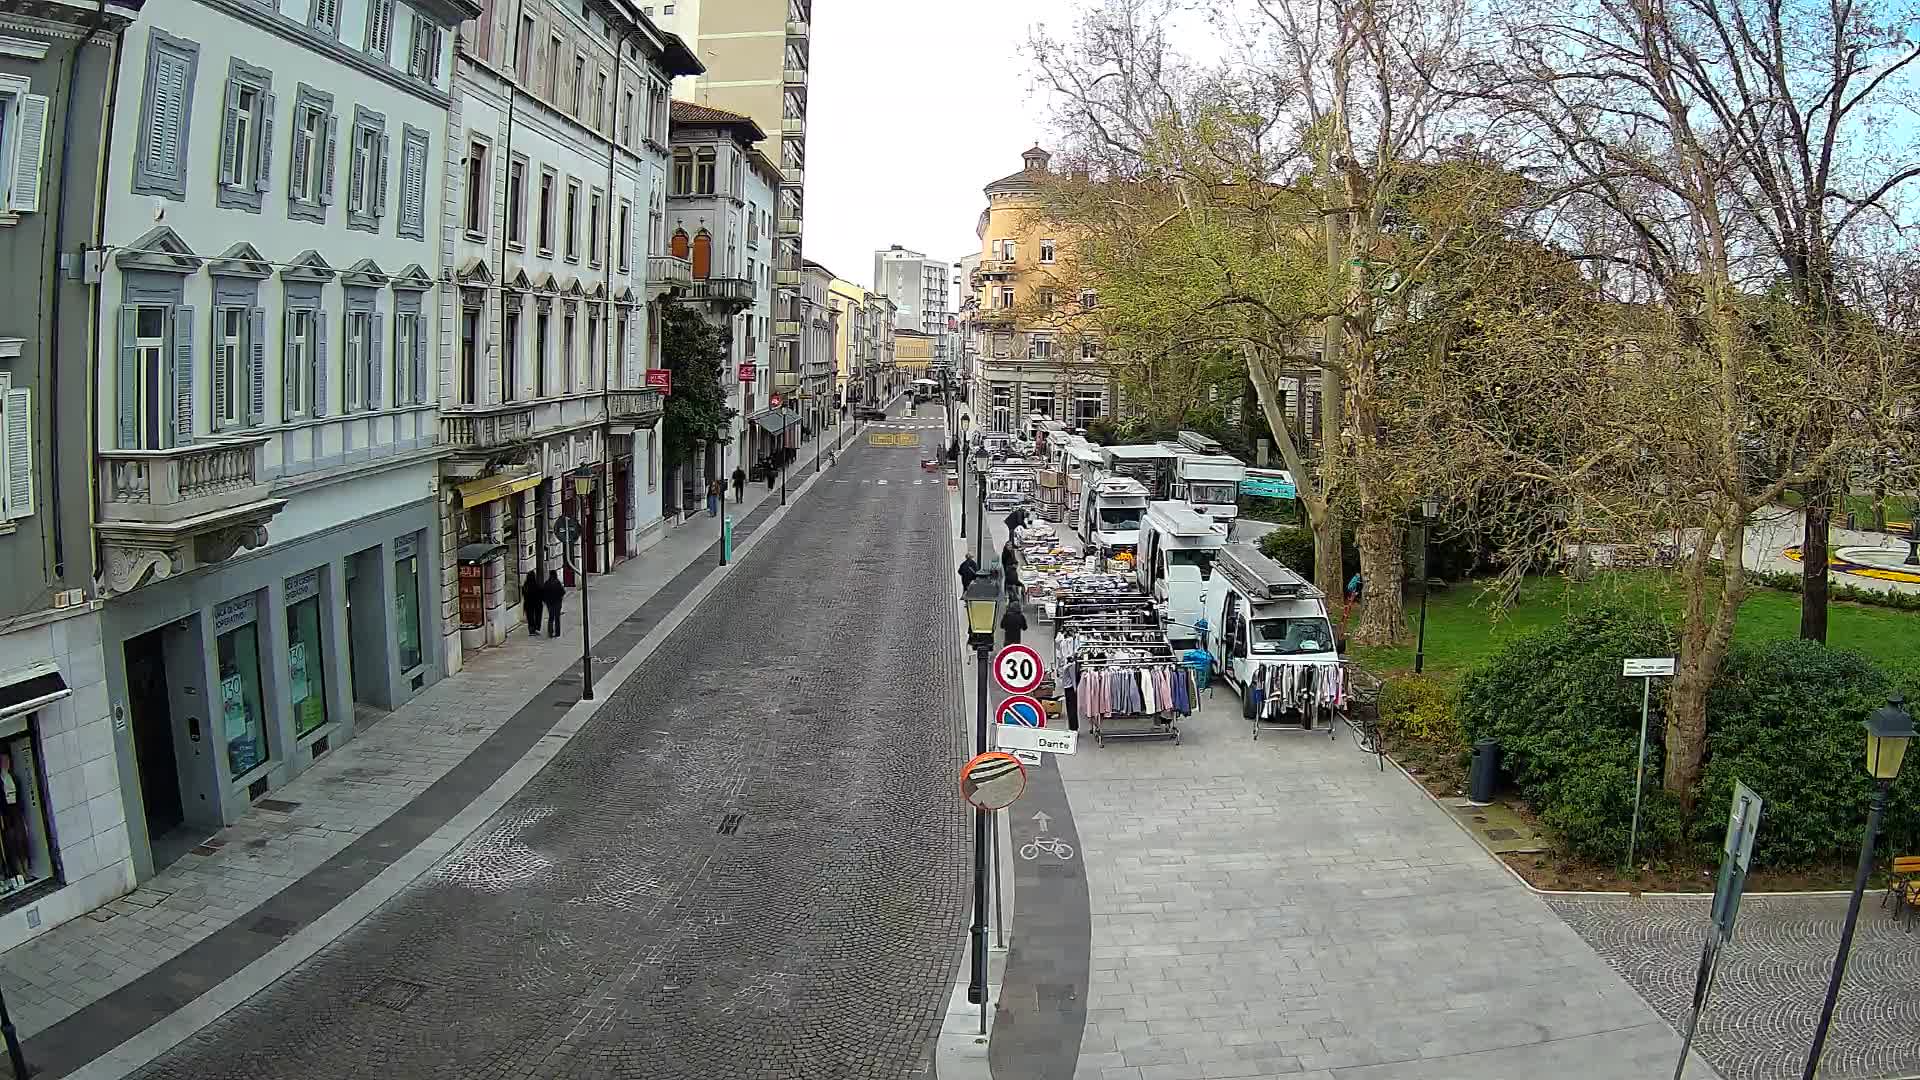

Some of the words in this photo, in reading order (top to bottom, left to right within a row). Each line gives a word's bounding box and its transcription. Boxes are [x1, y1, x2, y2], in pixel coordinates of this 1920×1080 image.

[215, 611, 245, 628] OPERATIVO
[1005, 658, 1033, 680] 30
[1038, 738, 1070, 750] Dante
